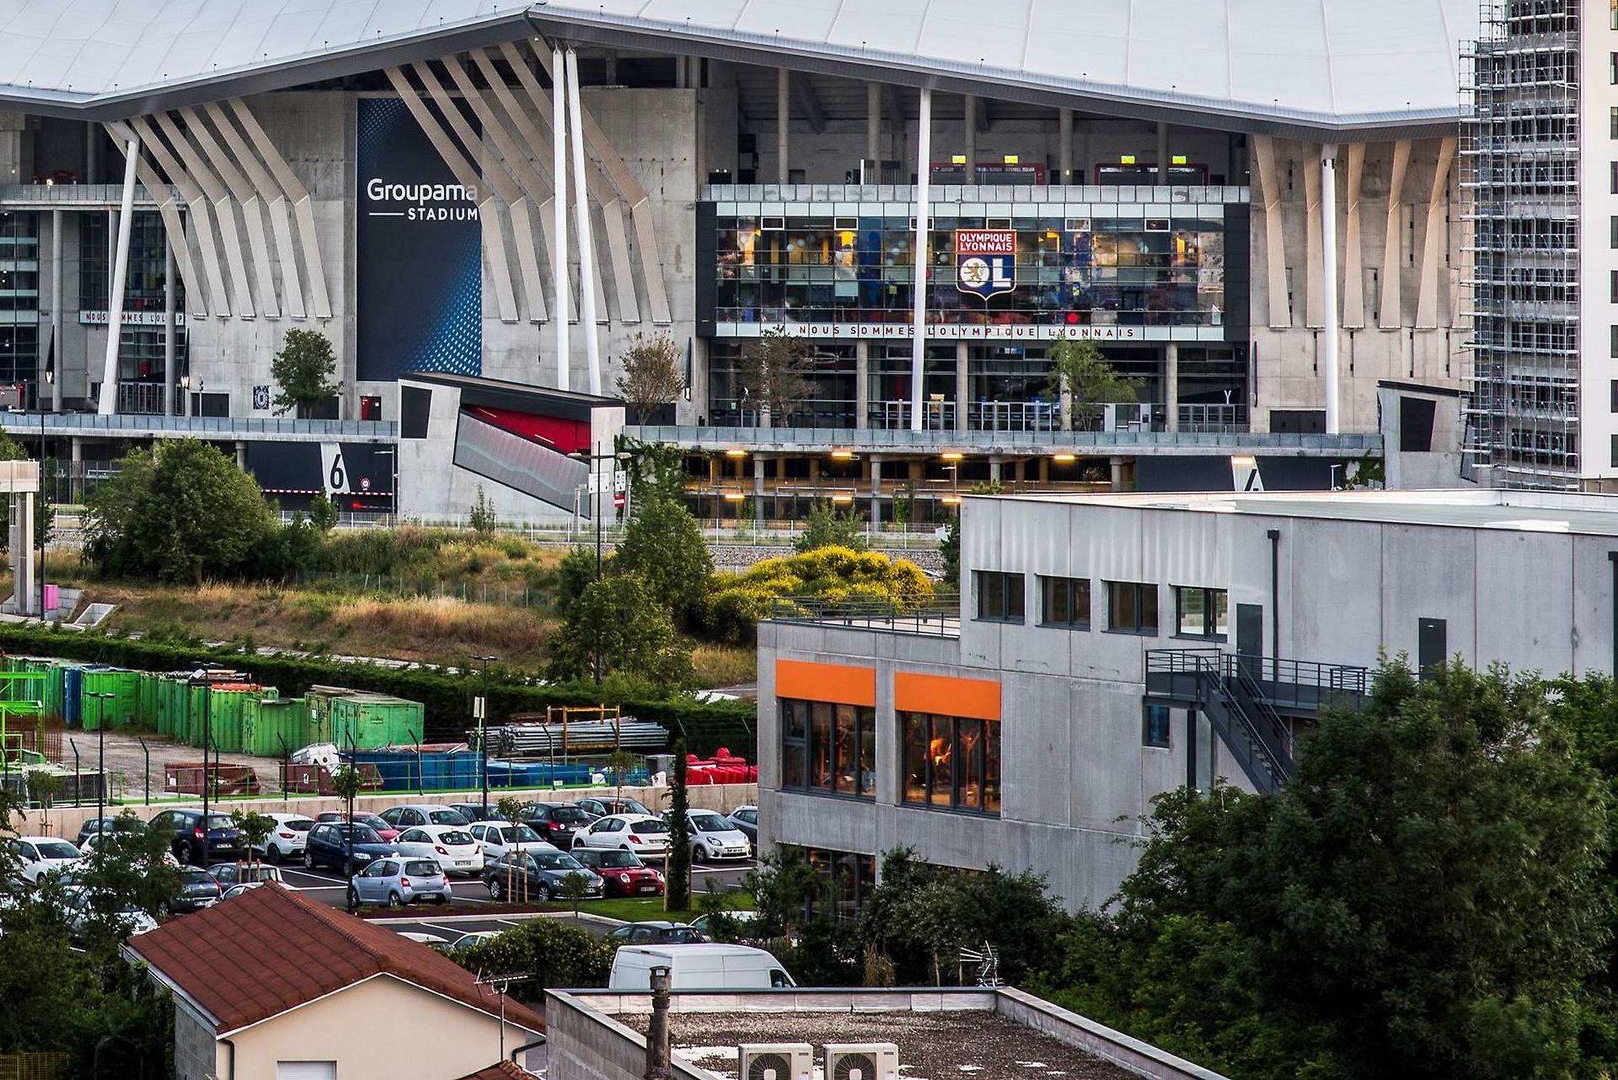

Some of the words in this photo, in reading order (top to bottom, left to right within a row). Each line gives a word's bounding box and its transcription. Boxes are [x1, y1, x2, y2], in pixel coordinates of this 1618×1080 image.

[367, 178, 478, 206] Groupama
[408, 207, 478, 221] STADIUM
[959, 233, 1013, 242] OLYMPIQUE
[959, 242, 1013, 251] LYONNAIS
[799, 326, 840, 335] NOUS
[850, 326, 915, 335] SOMMES
[1048, 328, 1134, 337] LYONNAIS
[330, 454, 344, 490] 6
